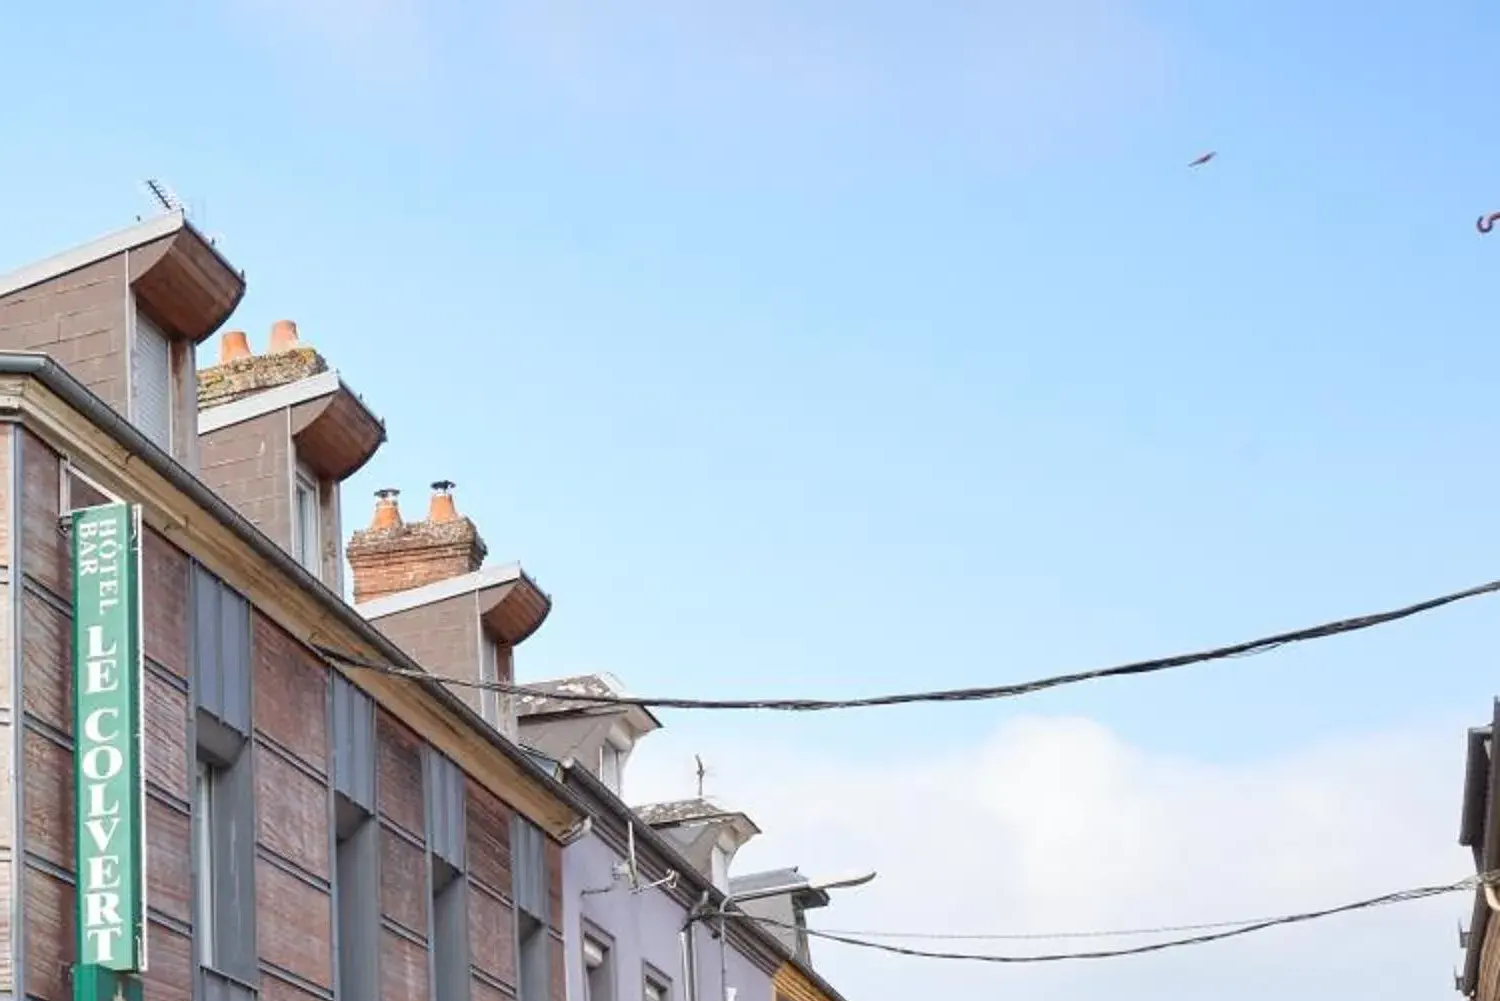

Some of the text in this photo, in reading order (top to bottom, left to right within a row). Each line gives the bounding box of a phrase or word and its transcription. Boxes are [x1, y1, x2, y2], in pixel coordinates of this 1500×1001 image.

[79, 521, 99, 577] BAR
[81, 624, 124, 964] LE COLVERT
